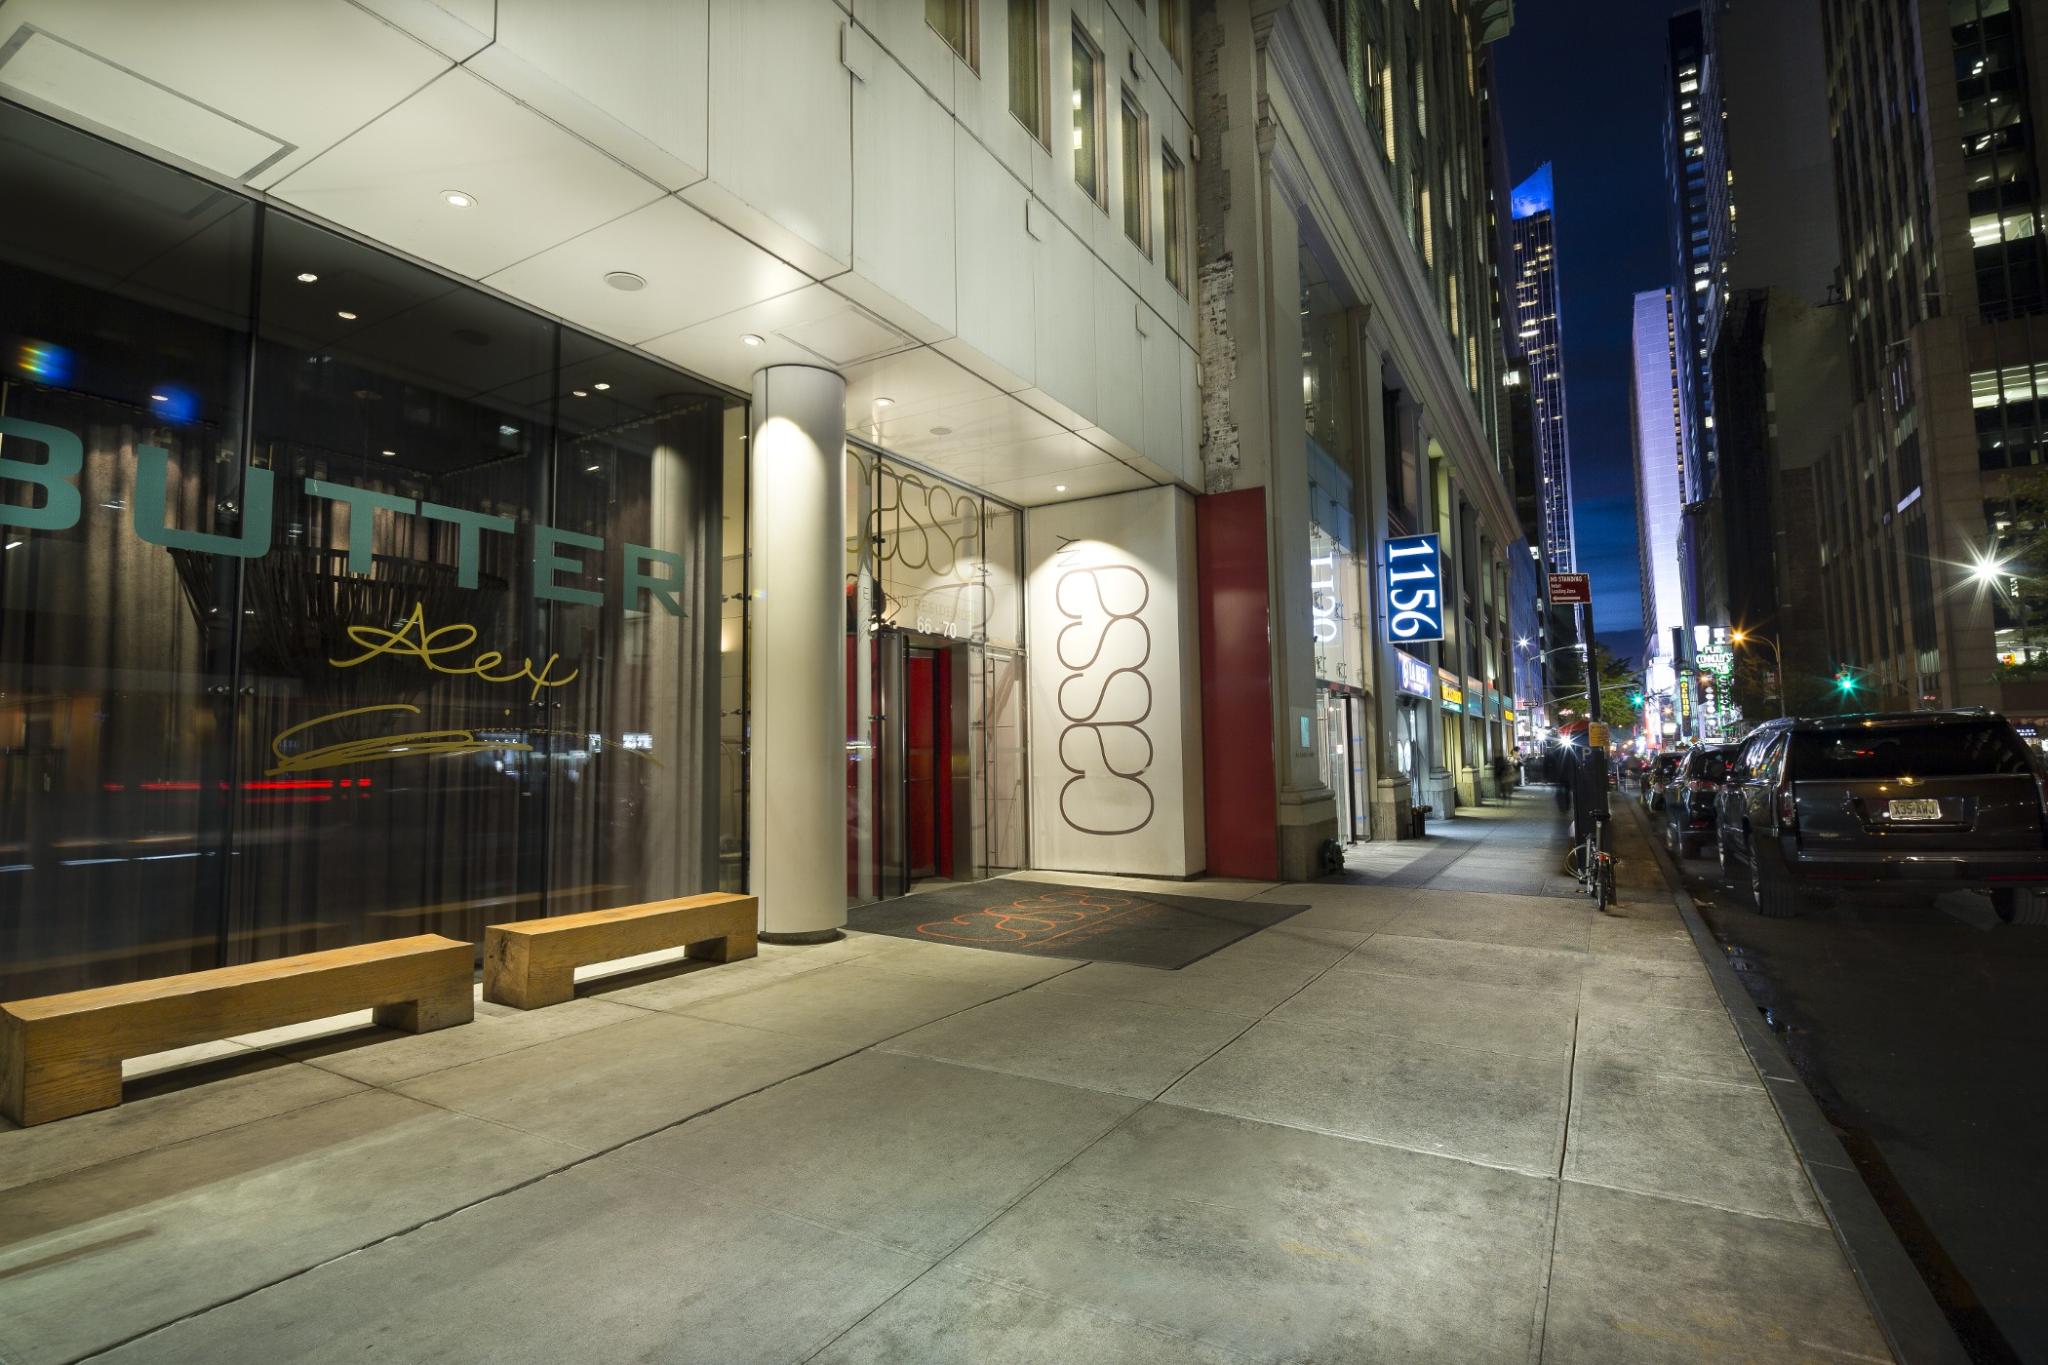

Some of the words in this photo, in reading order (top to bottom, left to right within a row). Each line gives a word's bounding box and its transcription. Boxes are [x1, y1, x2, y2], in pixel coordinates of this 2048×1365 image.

[0, 416, 688, 617] BUTTER
[917, 616, 932, 635] 66
[943, 620, 957, 639] 70
[1389, 539, 1438, 638] 1156
[329, 602, 579, 701] Alex
